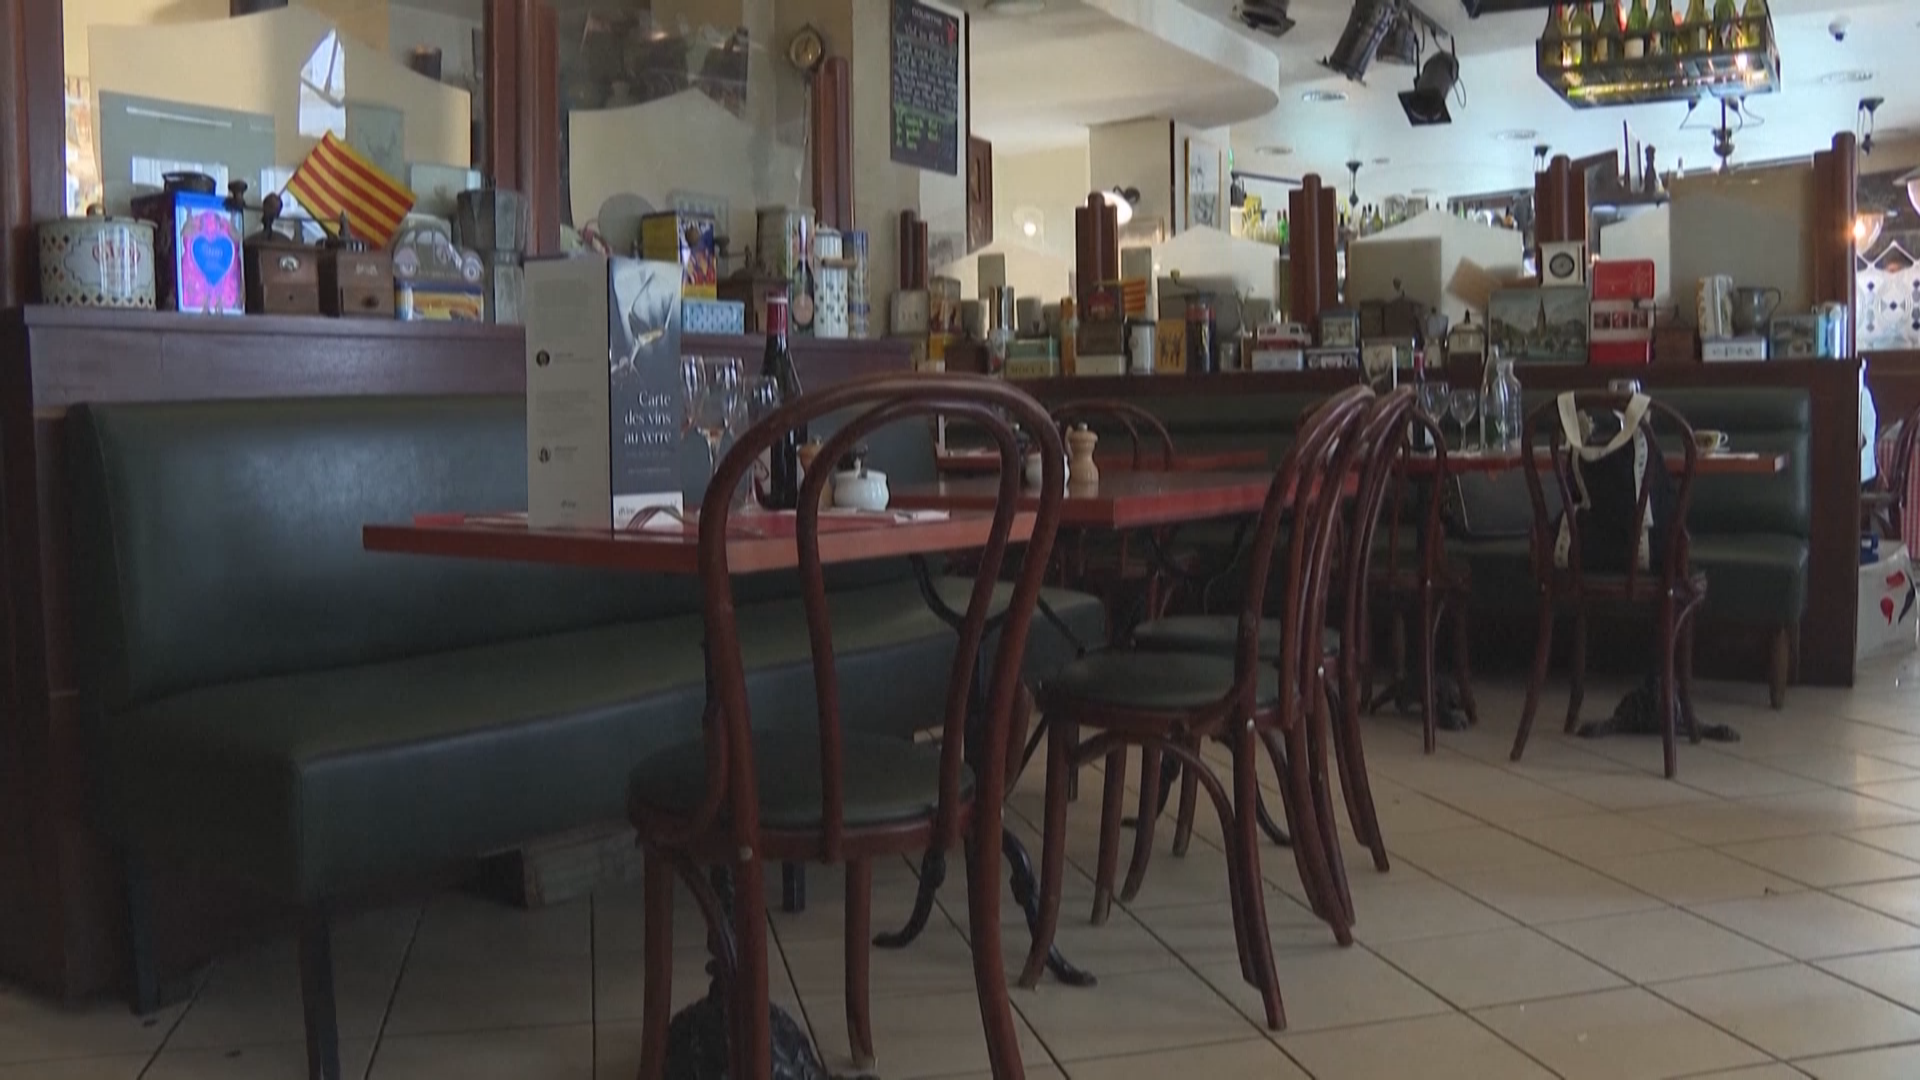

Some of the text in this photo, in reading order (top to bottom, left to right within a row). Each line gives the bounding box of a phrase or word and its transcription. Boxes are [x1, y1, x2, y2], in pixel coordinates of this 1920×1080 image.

[638, 390, 671, 407] Carte
[624, 407, 672, 425] des vins
[624, 431, 671, 445] au verre
